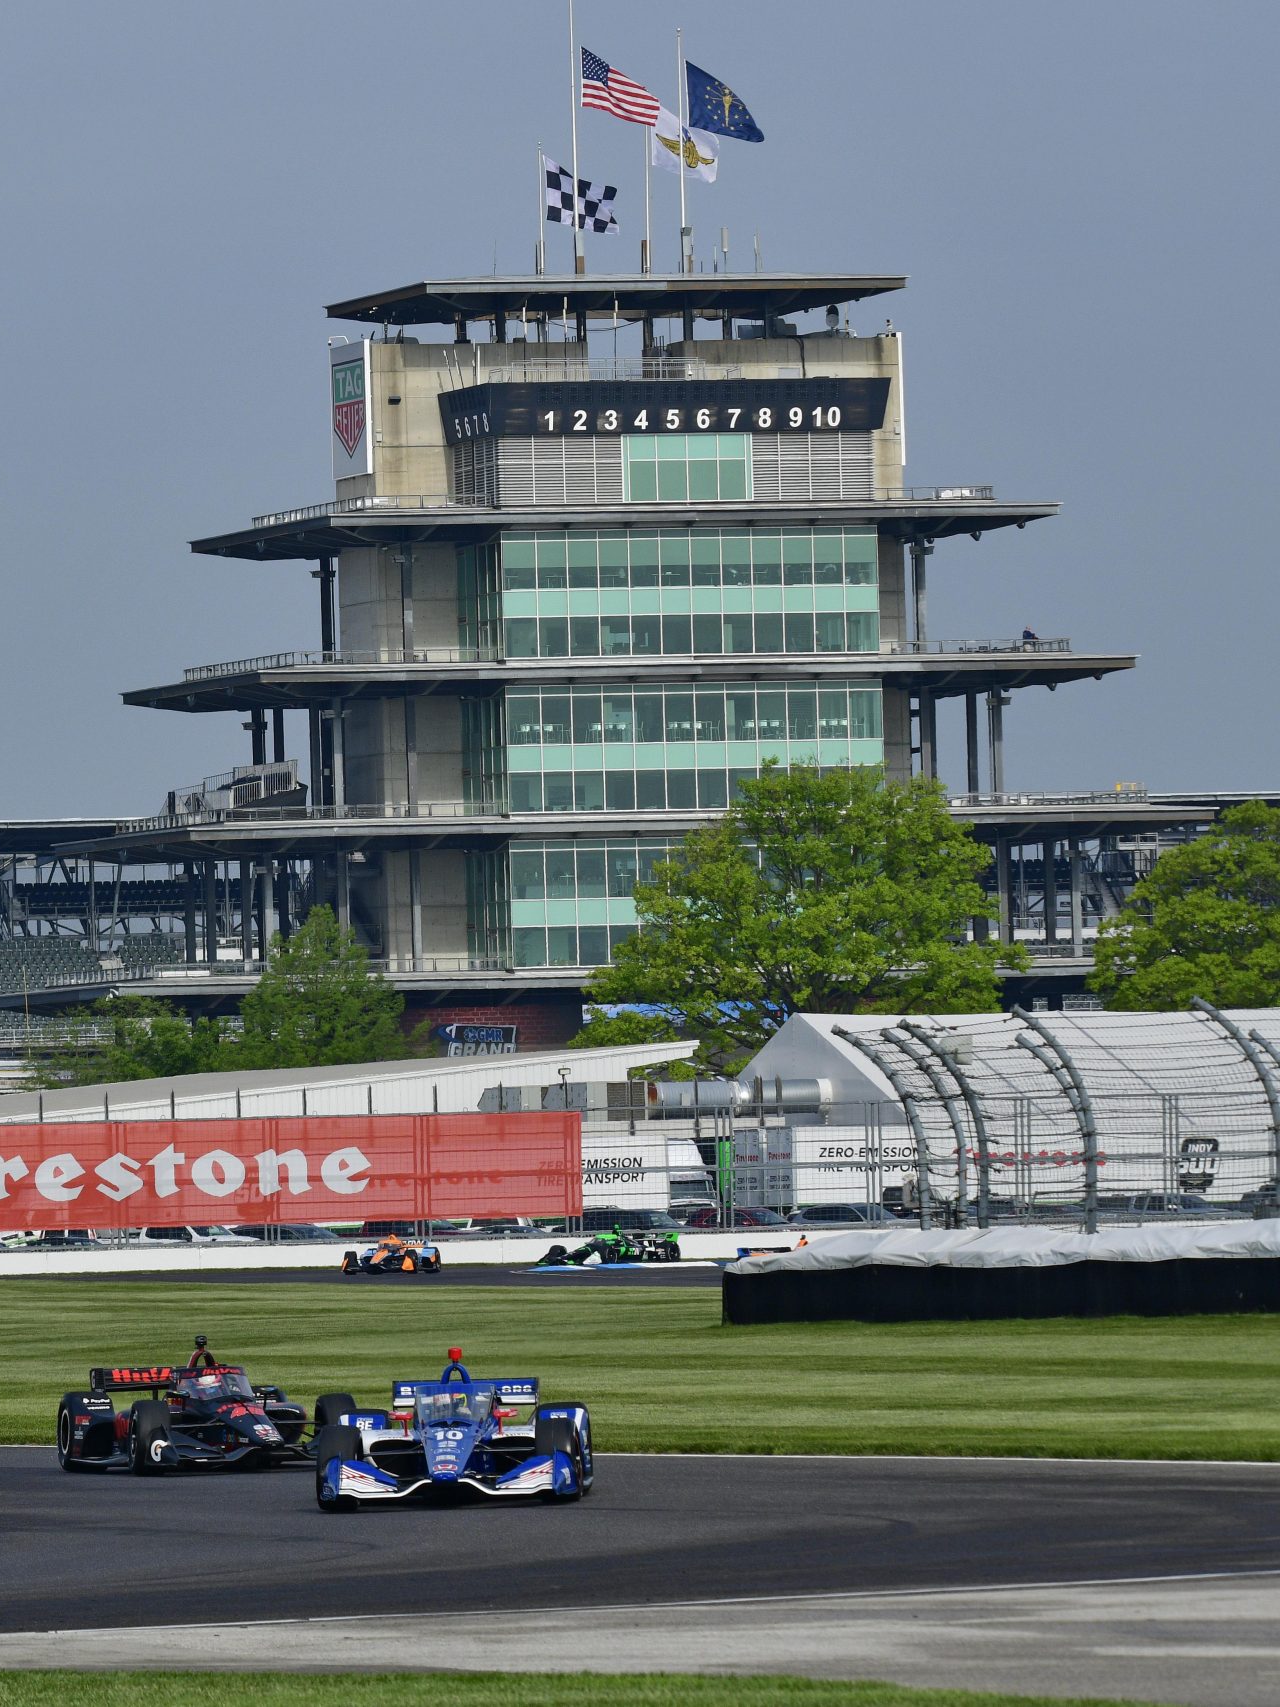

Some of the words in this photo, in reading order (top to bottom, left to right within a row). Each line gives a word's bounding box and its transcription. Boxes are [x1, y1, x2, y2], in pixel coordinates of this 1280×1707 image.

[336, 368, 362, 399] TAG
[336, 404, 364, 447] HEUER
[455, 418, 462, 439] 5
[464, 416, 471, 437] 6
[473, 415, 480, 435] 7
[482, 413, 489, 433] 8
[544, 411, 554, 431] 1
[573, 410, 587, 431] 2
[604, 410, 618, 430] 3
[634, 409, 648, 430] 4
[666, 409, 679, 429] 5
[696, 408, 710, 429] 6
[727, 409, 741, 428] 7
[758, 407, 771, 428] 8
[789, 407, 803, 427] 9
[812, 406, 841, 427] 10
[477, 1028, 503, 1042] GMR
[450, 1042, 515, 1057] GRAND
[819, 1147, 920, 1158] ZERO-EMSSION
[1188, 1144, 1213, 1153] INDY
[539, 1156, 643, 1171] ZEREMISSION
[537, 1175, 563, 1187] TIRE
[569, 1172, 647, 1185] RANSPORT
[434, 1430, 463, 1440] 10
